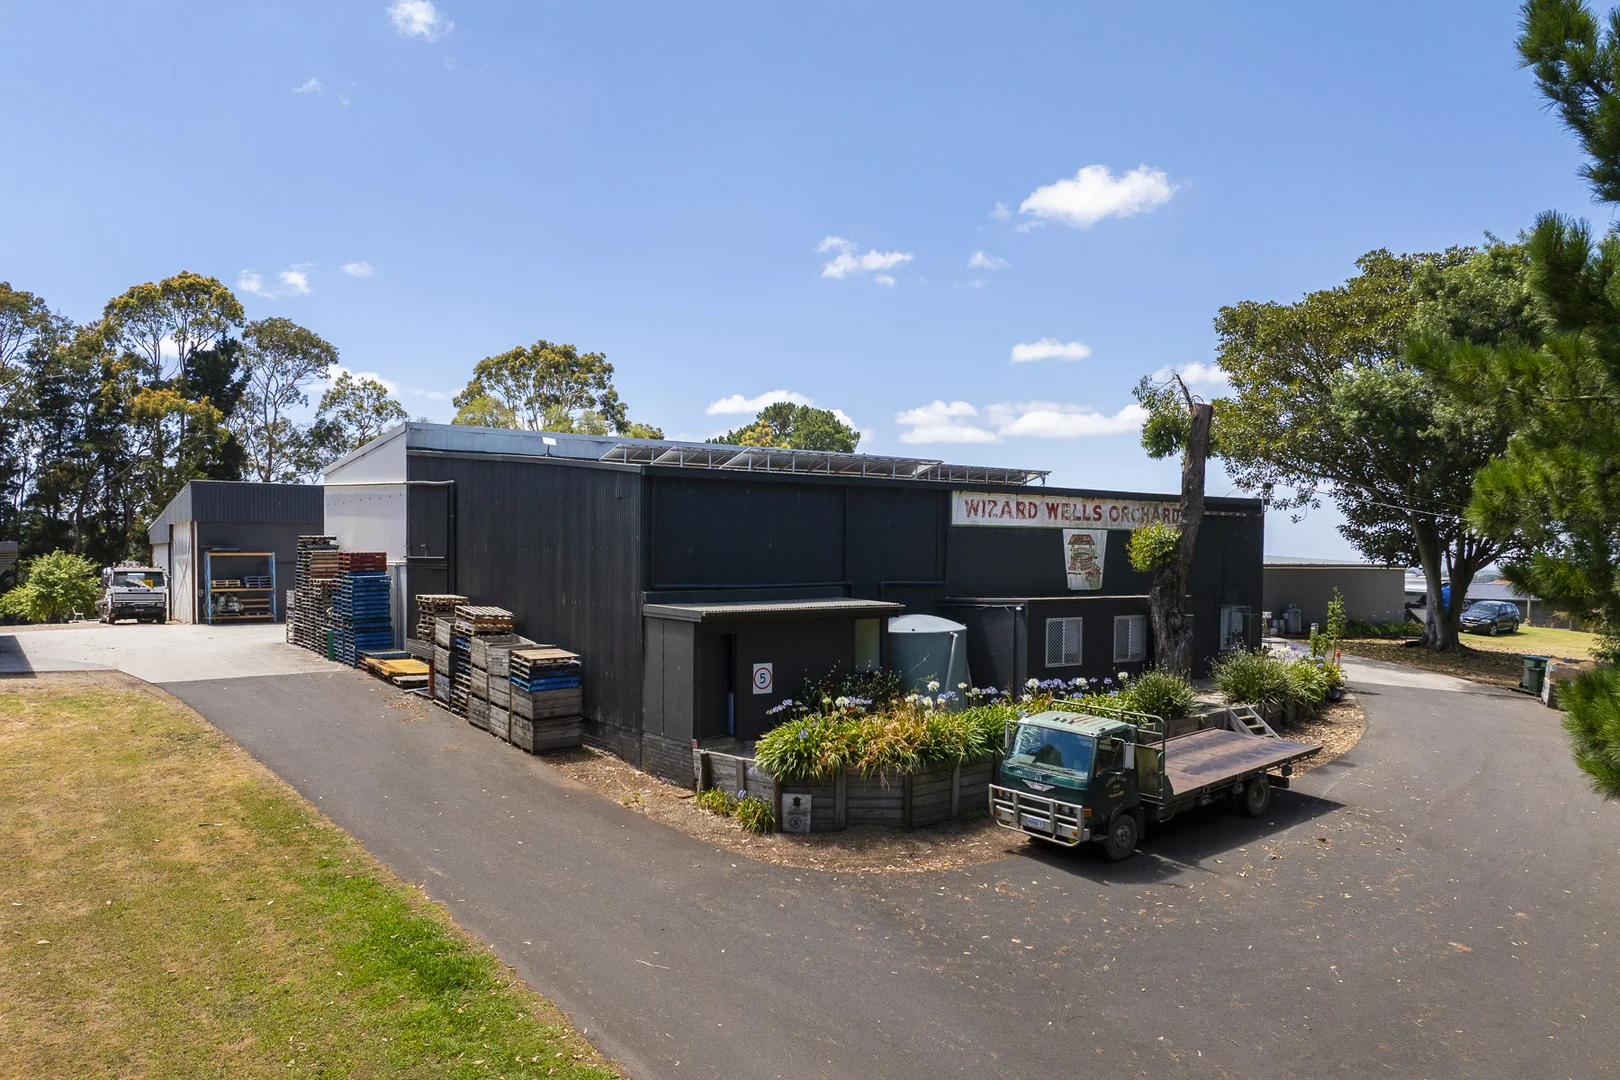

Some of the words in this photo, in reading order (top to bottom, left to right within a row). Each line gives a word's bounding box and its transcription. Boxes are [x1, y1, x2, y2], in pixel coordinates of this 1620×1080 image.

[965, 499, 1038, 519] WIZARD
[1046, 502, 1103, 522] WELLS
[759, 672, 766, 685] 5
